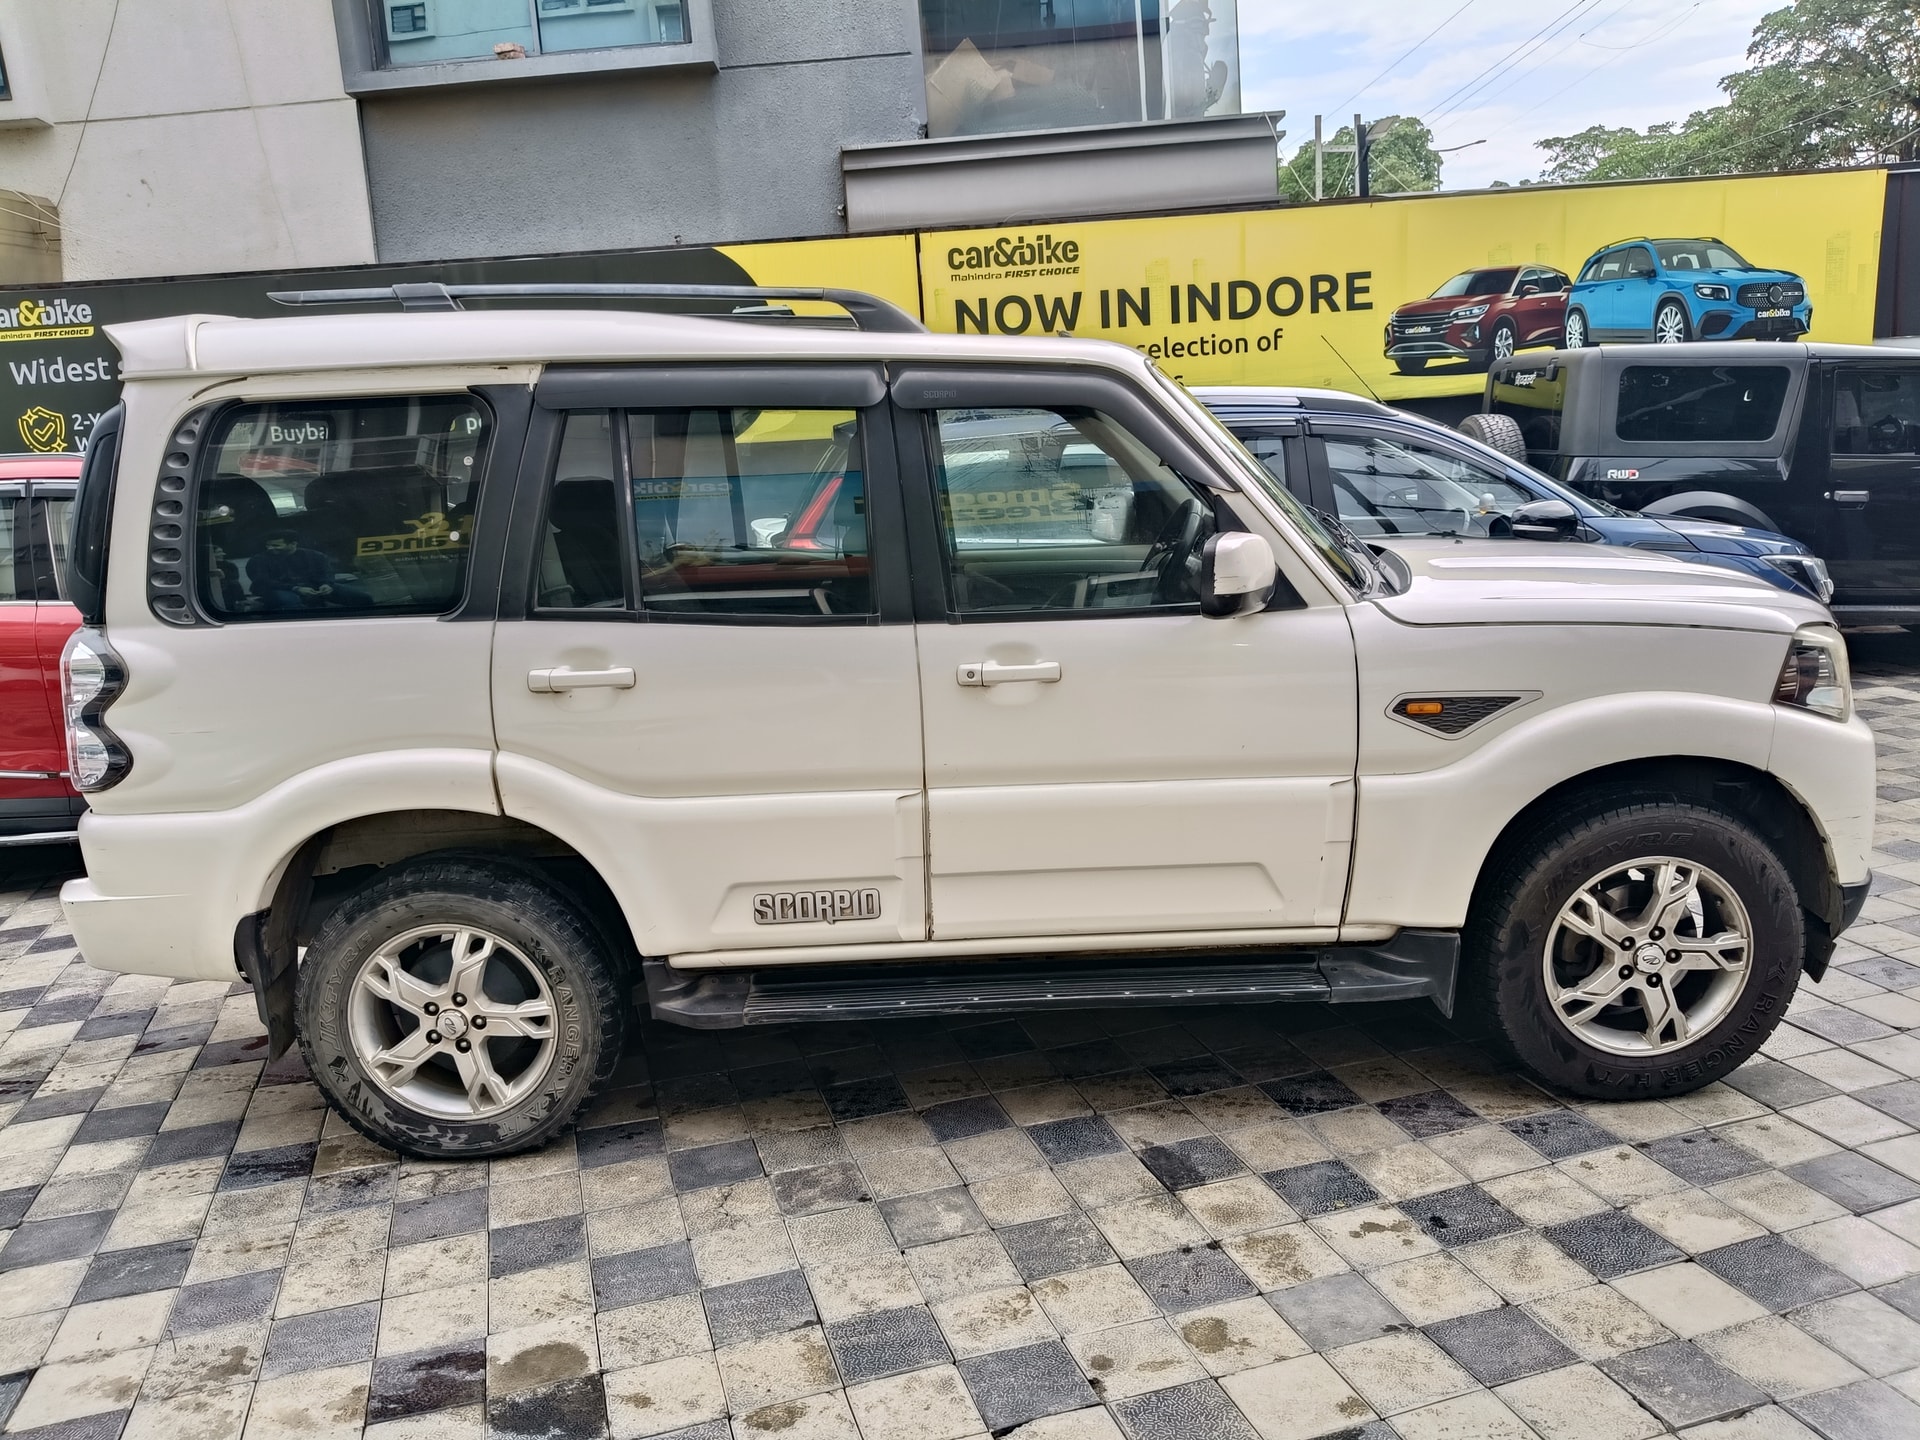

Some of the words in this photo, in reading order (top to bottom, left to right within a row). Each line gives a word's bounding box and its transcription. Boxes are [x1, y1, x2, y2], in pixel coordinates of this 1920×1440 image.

[947, 234, 1080, 271] car&bike
[950, 272, 1002, 282] Mahindra
[1004, 269, 1038, 279] FIRST
[1039, 266, 1080, 277] CHOICE
[955, 291, 1083, 336] NOW
[1100, 287, 1151, 329] IN
[1170, 271, 1374, 324] INDORE
[34, 330, 59, 338] FIRST
[59, 328, 90, 336] CHOICE
[1256, 328, 1284, 352] of
[9, 356, 112, 386] Widest
[1607, 469, 1640, 480] RWD
[753, 887, 882, 925] SCORPIO
[549, 964, 581, 1078] RANGER
[1661, 992, 1778, 1086] RANGER
